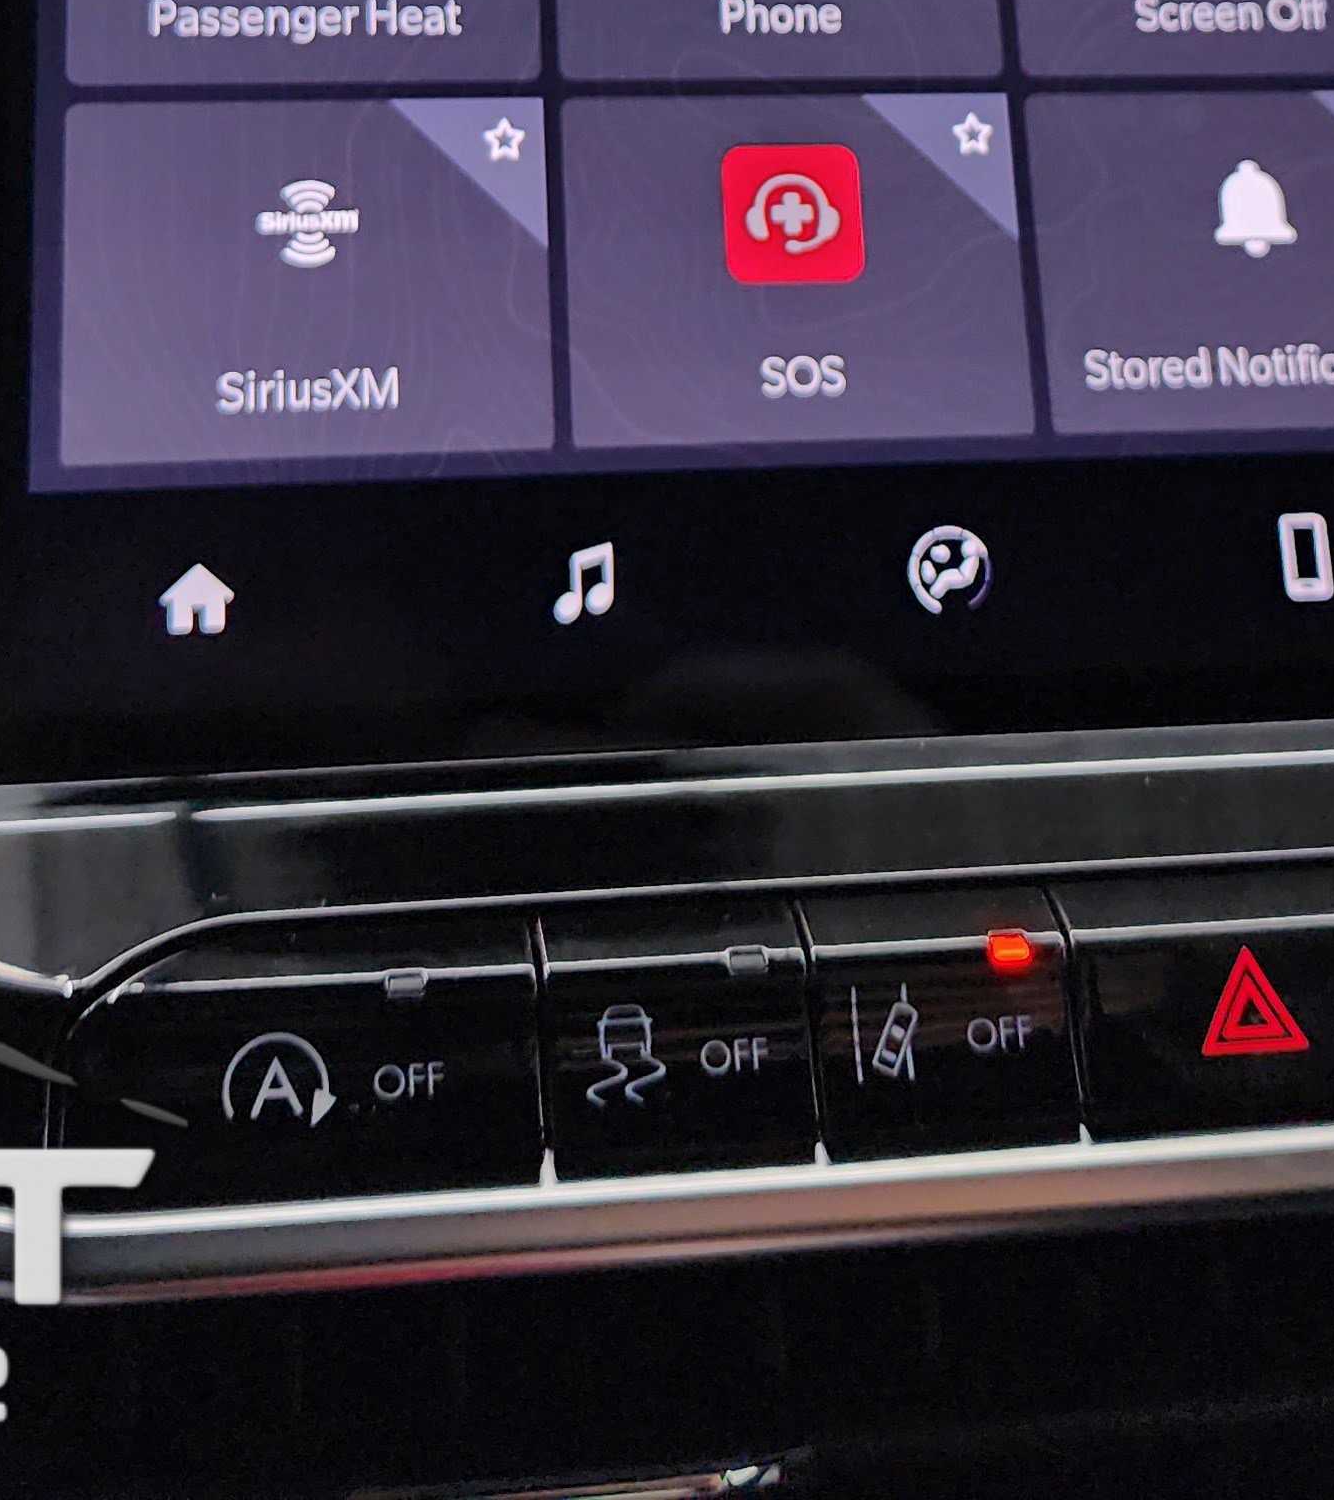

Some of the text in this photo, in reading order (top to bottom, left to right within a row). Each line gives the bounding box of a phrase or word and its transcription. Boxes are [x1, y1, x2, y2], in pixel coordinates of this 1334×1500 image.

[760, 355, 847, 399] SOS
[1084, 347, 1212, 390] Stored
[216, 367, 399, 415] SiriusXM
[966, 1015, 1033, 1053] OFF
[699, 1037, 769, 1076] OFF
[373, 1061, 445, 1101] OFF
